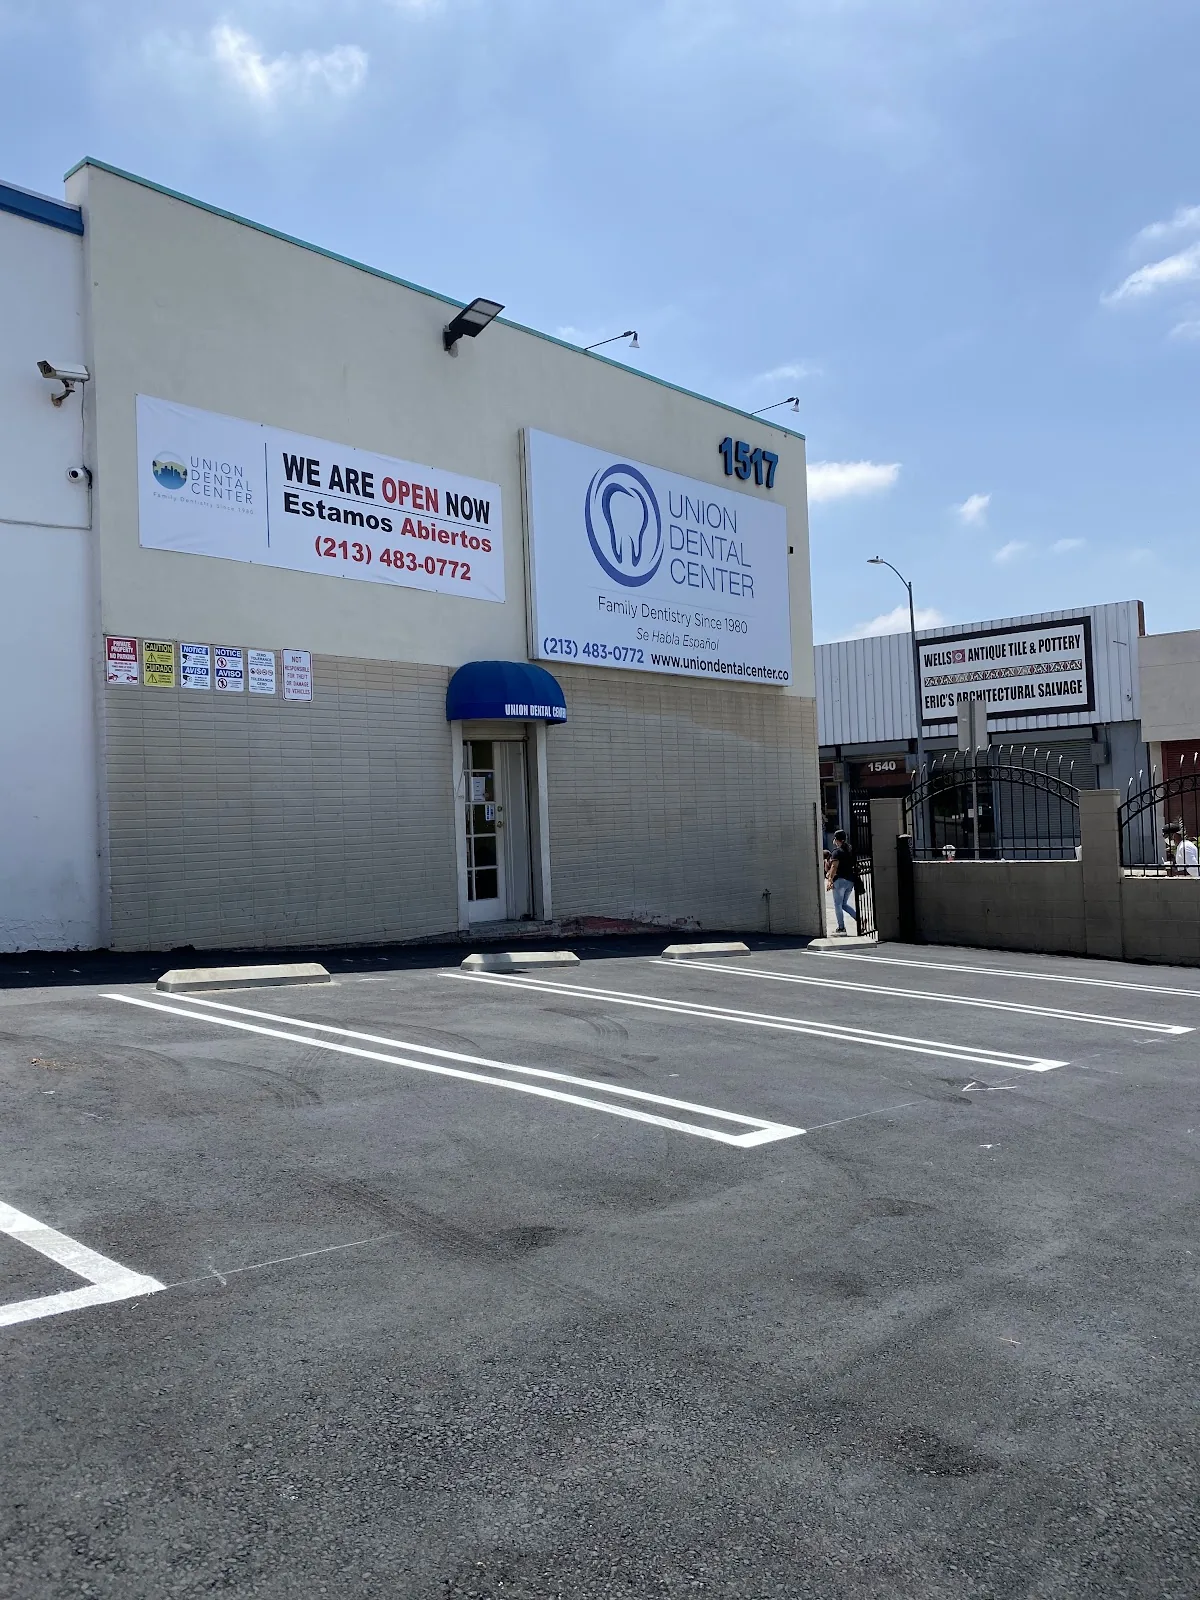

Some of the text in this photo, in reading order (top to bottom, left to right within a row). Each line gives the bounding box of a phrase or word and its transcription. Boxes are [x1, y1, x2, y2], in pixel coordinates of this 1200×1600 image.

[190, 455, 243, 478] UNION
[719, 436, 779, 489] 1517
[191, 469, 253, 492] DENTAL
[283, 453, 490, 525] WE ARE OPEN NOW
[153, 491, 177, 502] Family
[180, 496, 213, 508] Dentistry
[216, 503, 235, 511] Since
[191, 482, 253, 505] CENTER
[283, 491, 492, 553] Estamos Abiertos
[668, 490, 737, 533] UNION
[669, 524, 752, 567] DENTAL
[315, 535, 471, 581] (213) 483-0772
[670, 558, 755, 599] CENTER
[598, 595, 748, 634] Family Dentistry Since 1980
[145, 643, 173, 653] CAUTION
[183, 645, 208, 655] NOTICE
[636, 627, 719, 651] Se Habla Español
[215, 649, 242, 658] NOTICE
[543, 637, 789, 682] (213) 483-0772 www.uniondentalcenter.co
[924, 634, 1081, 668] WELLS ANTIQUE TILE & POTTERY
[145, 664, 173, 673] CUIDADO
[184, 666, 207, 675] AVISO
[217, 669, 241, 678] AVISO
[924, 680, 1083, 709] ERIC'S ARCHITECTURAL SALVAGE
[505, 704, 529, 716] UNION
[530, 704, 552, 718] DENTAL
[867, 761, 897, 772] 1540
